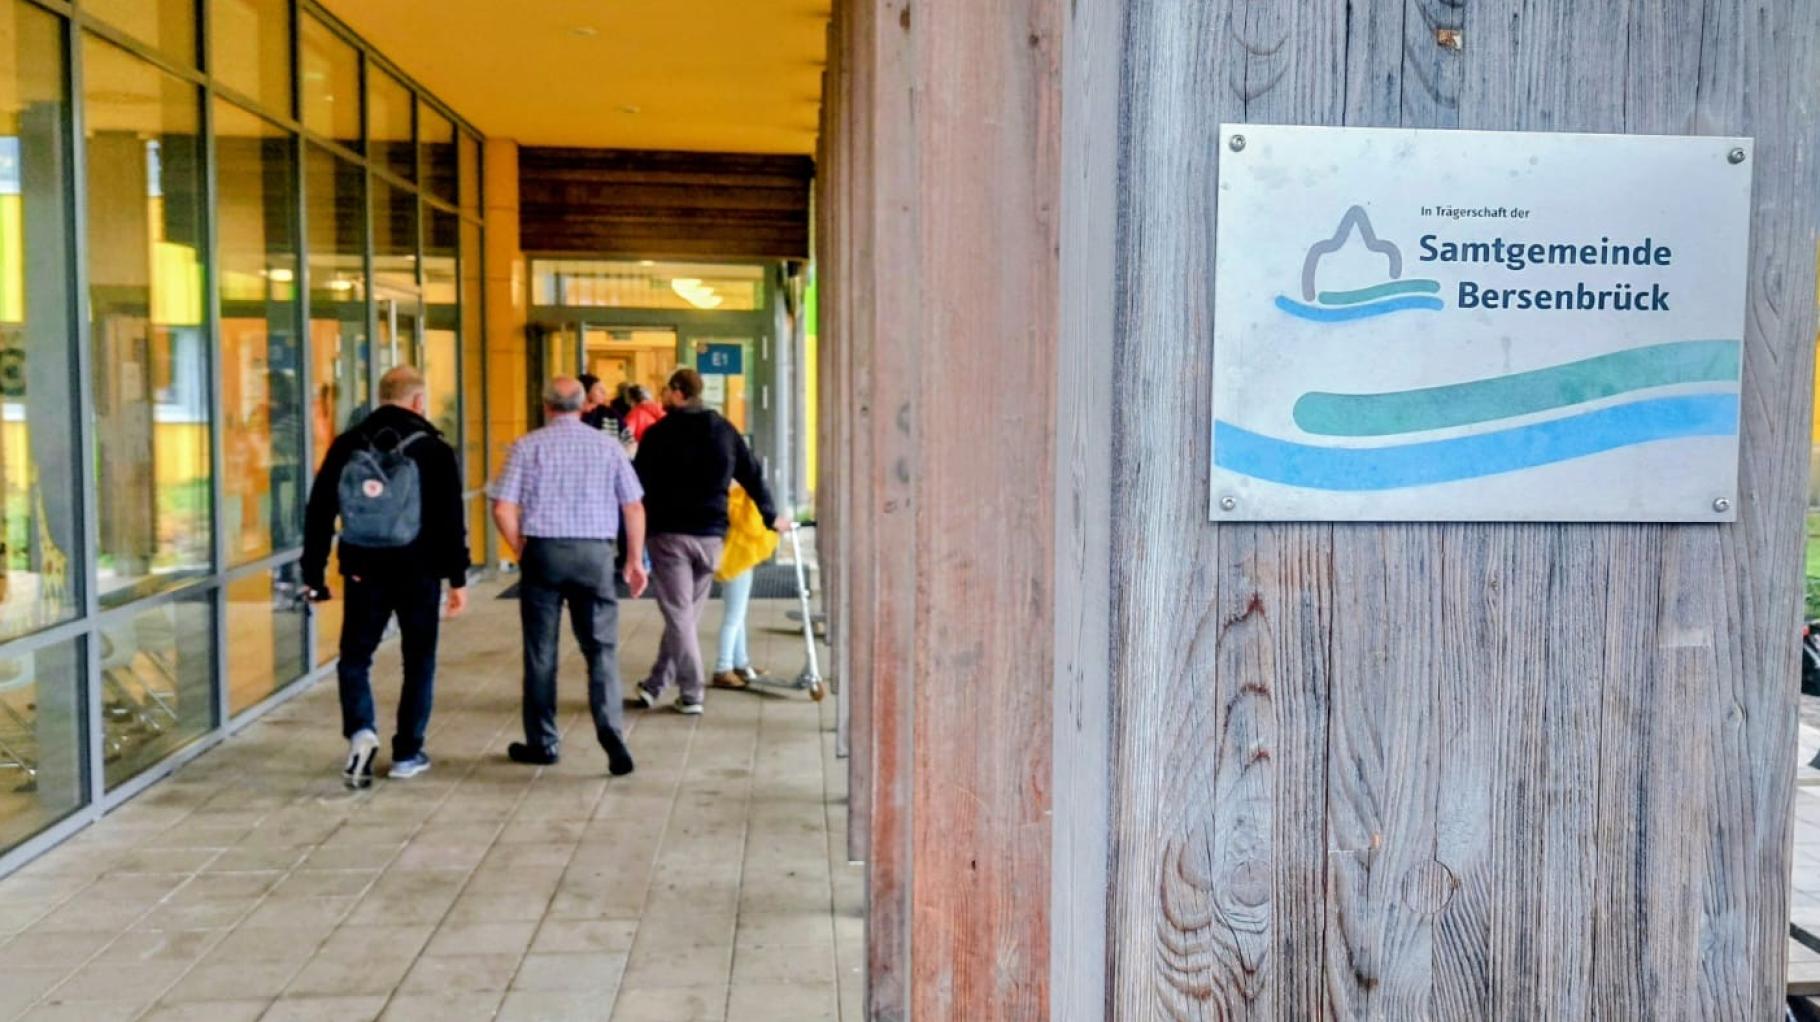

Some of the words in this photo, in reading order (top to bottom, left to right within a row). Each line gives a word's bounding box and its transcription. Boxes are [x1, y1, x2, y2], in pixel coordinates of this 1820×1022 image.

[1420, 206, 1432, 217] In
[1435, 205, 1507, 220] Trägerschaft
[1509, 207, 1530, 219] der
[1419, 234, 1672, 271] Samtgemeinde
[1458, 281, 1670, 311] Bersenbrück
